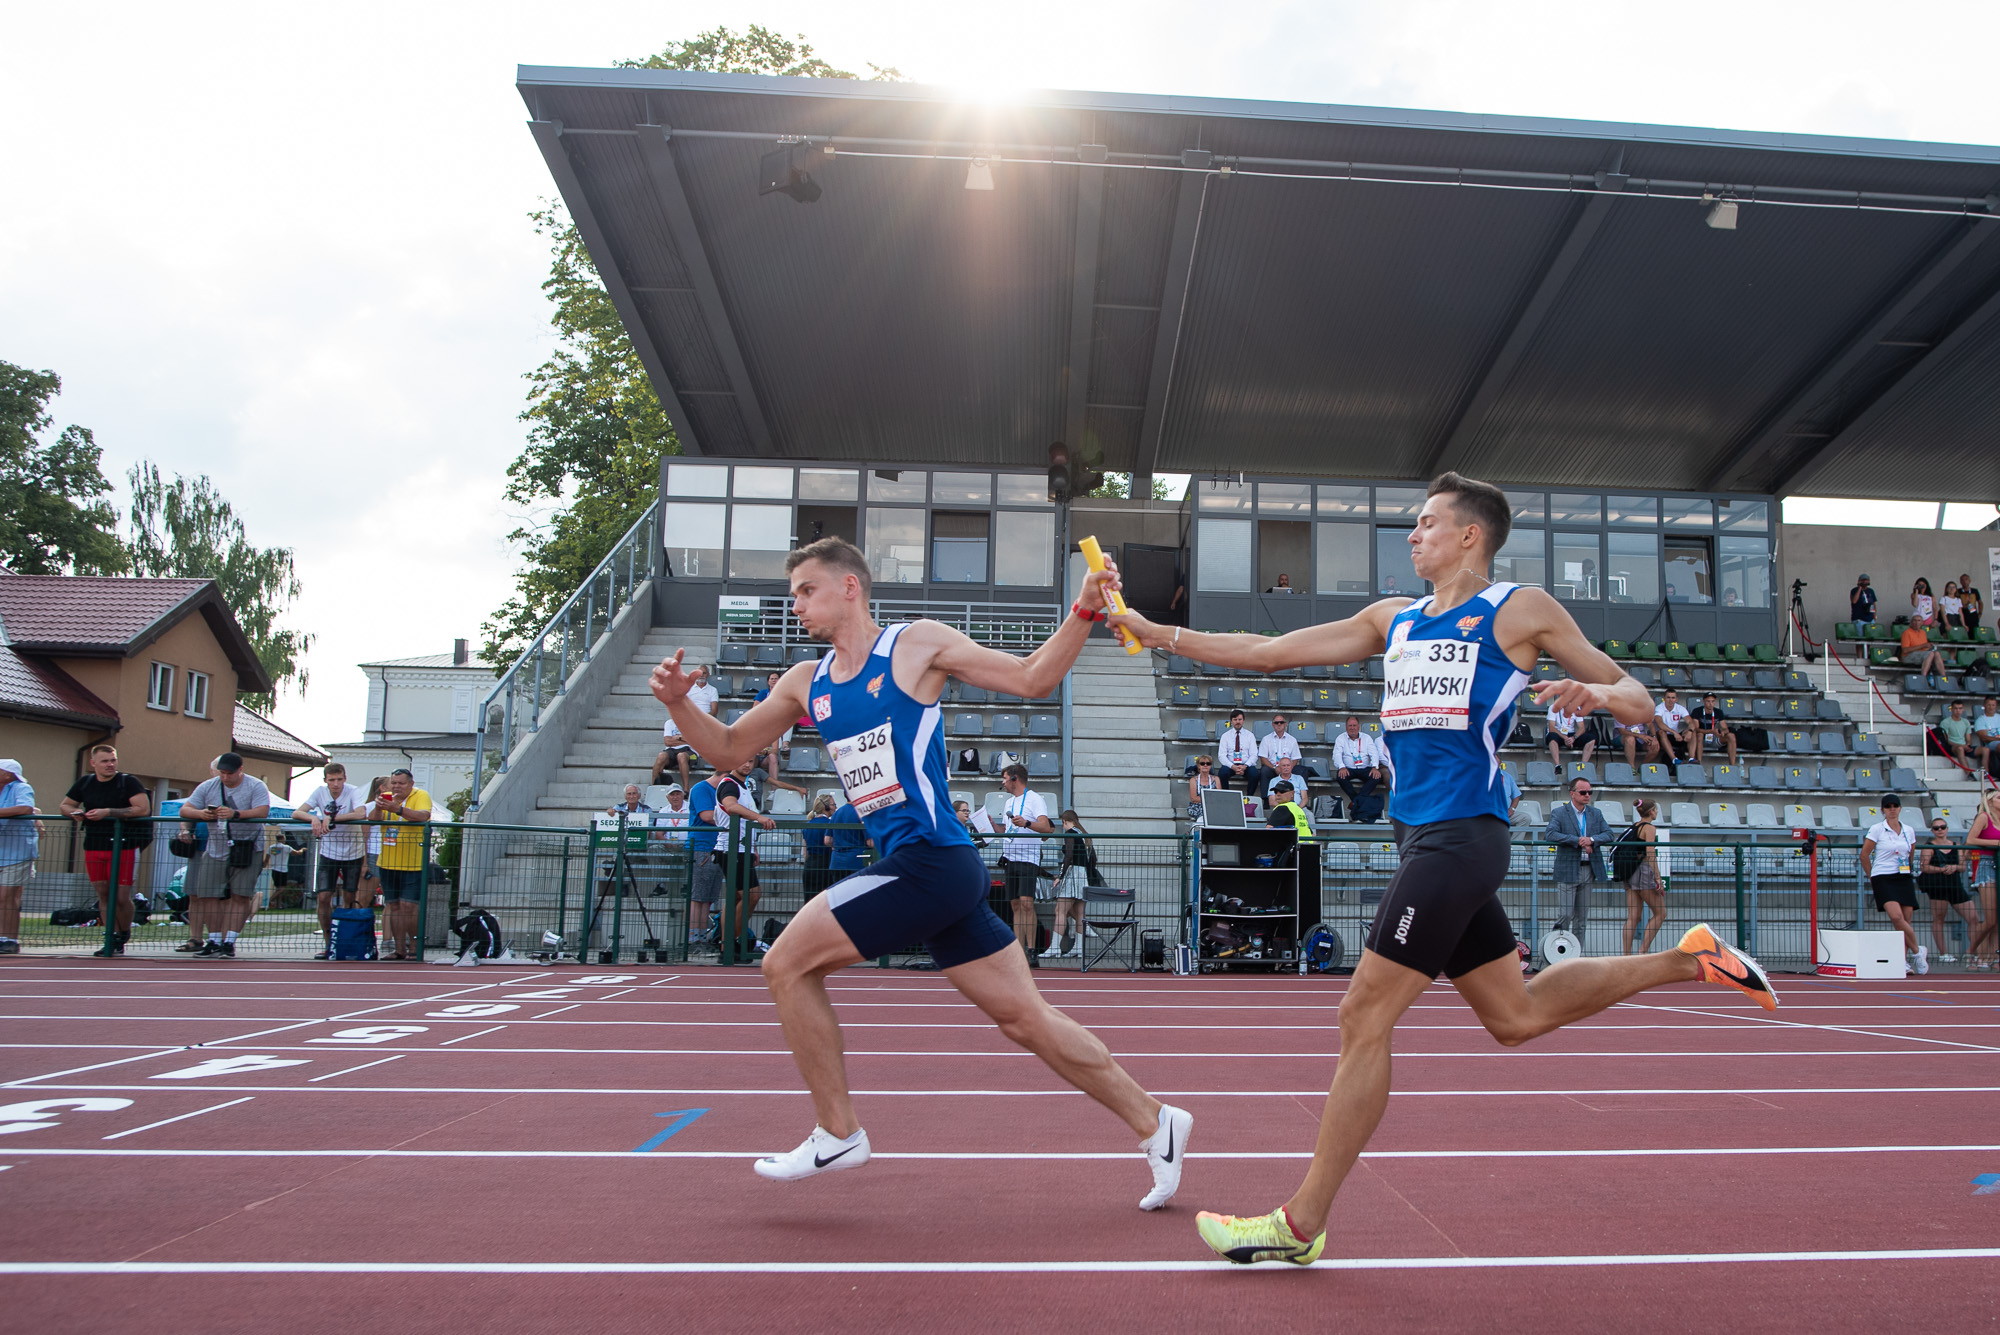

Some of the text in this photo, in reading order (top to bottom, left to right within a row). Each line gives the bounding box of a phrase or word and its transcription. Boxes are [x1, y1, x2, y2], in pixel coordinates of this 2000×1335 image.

[1429, 643, 1469, 663] 331
[1387, 676, 1468, 699] MAJEWSKI
[1425, 716, 1449, 727] 2021
[857, 728, 886, 753] 326
[843, 761, 884, 790] DZIDA
[877, 795, 896, 808] 2021
[600, 819, 642, 827] SĘDZWIE
[303, 1025, 430, 1044] 5
[147, 1055, 314, 1079] 4
